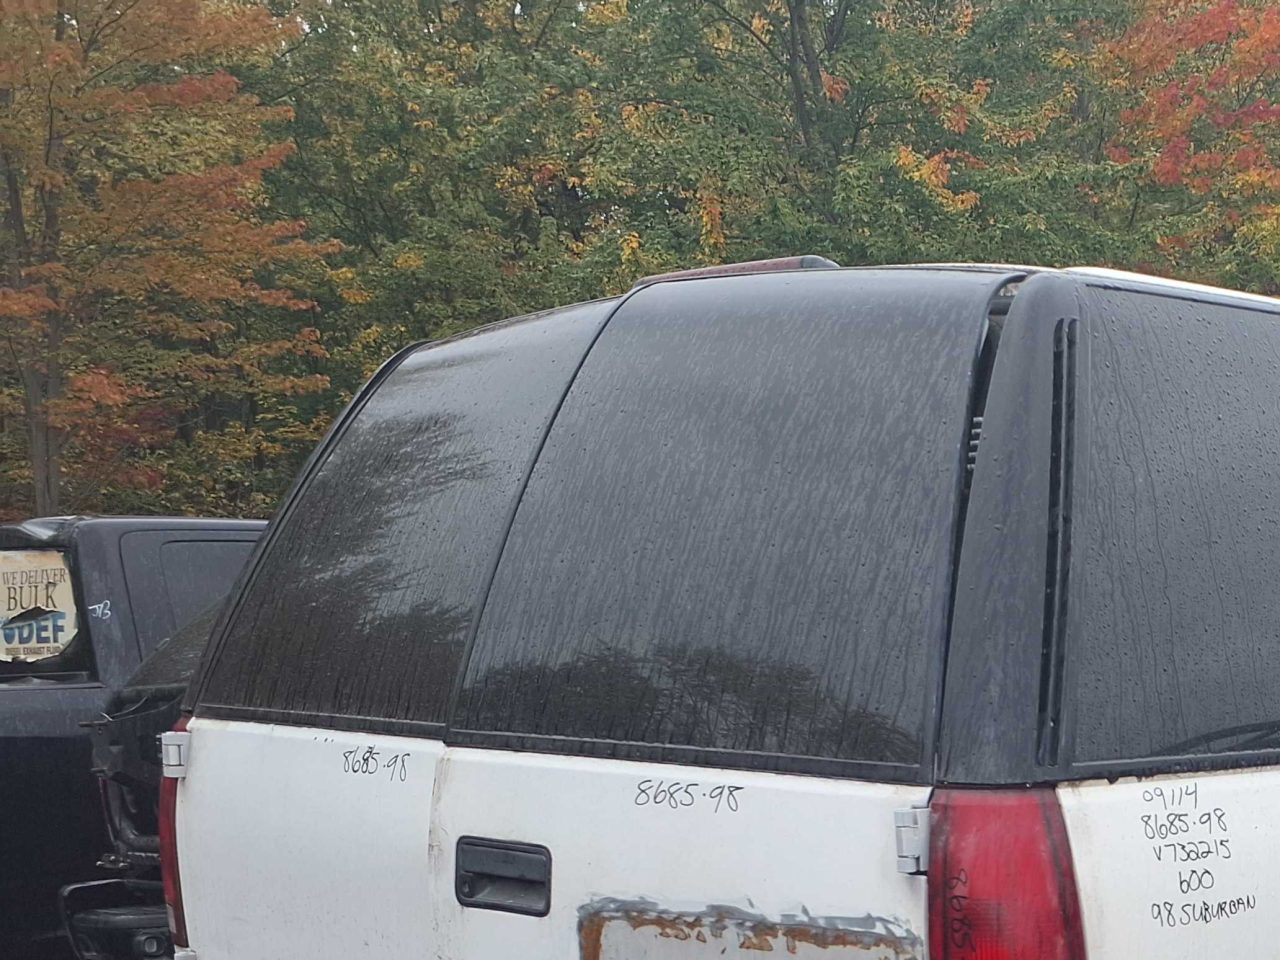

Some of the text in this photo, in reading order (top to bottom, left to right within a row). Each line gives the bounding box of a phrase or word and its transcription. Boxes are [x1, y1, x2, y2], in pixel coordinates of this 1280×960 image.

[2, 568, 67, 585] WE DELIVER
[7, 582, 58, 611] BULK
